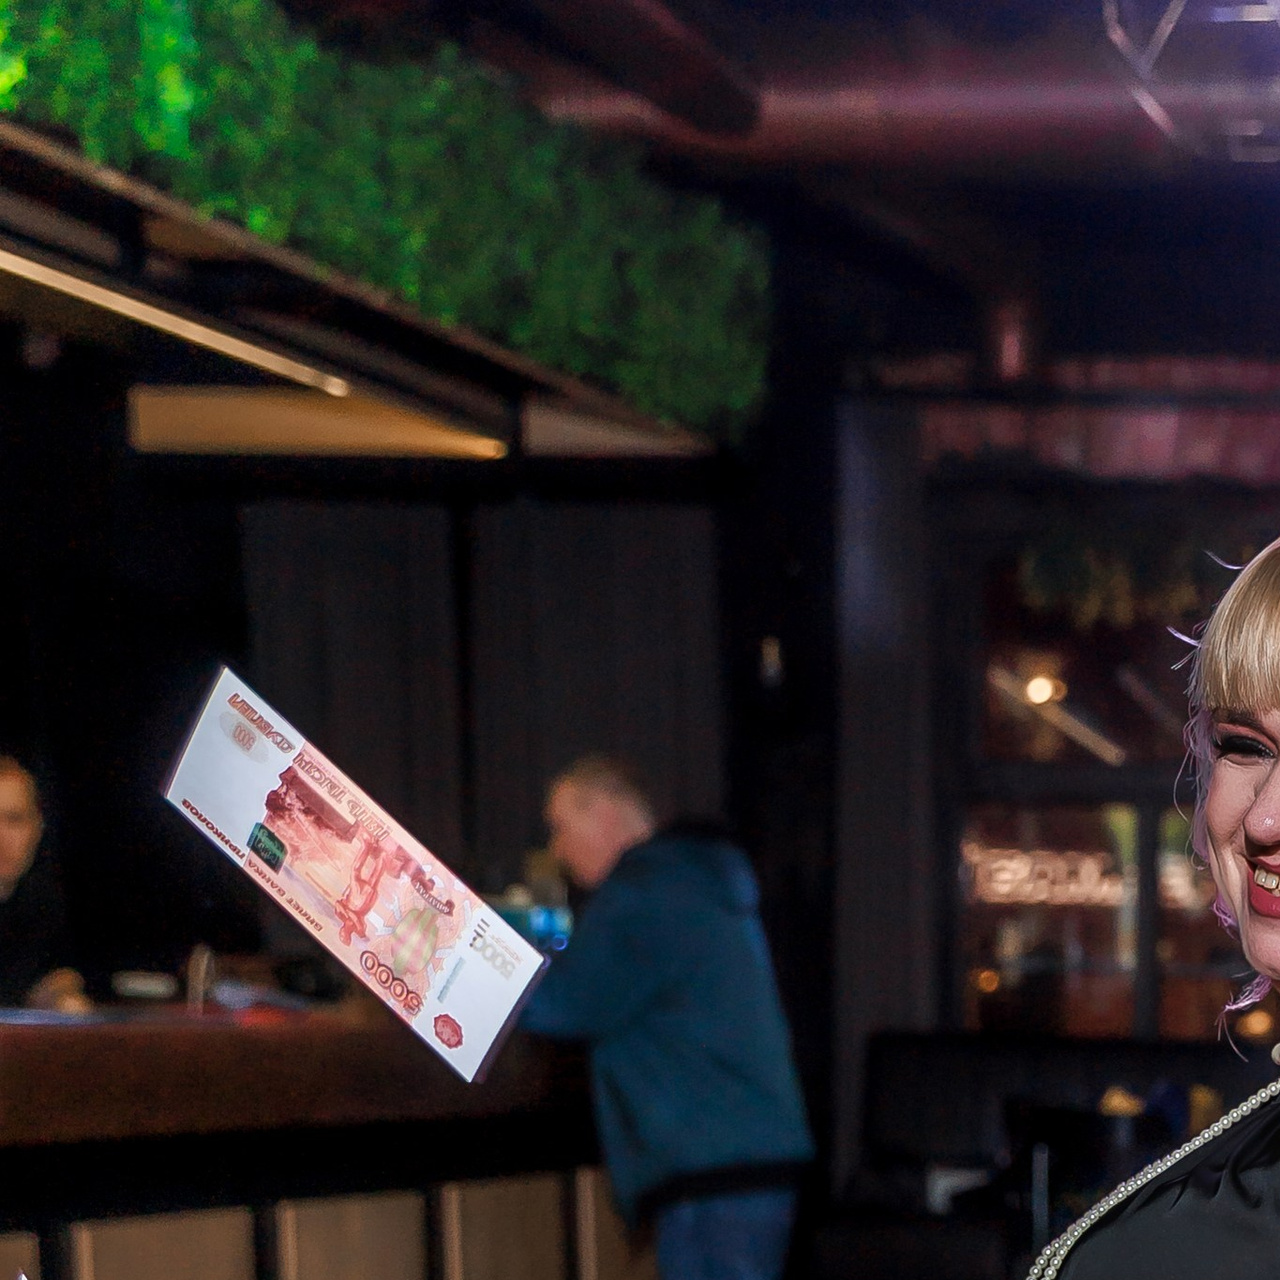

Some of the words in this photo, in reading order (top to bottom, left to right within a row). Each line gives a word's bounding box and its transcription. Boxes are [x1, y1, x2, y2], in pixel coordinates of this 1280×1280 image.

[229, 691, 293, 756] ДУБЛЕЙ
[295, 752, 344, 802] ТЫСЯЧ
[182, 798, 244, 859] ПРИКОЛОВ
[248, 860, 284, 896] БАНКА
[287, 896, 321, 931] БИЛЕТ
[358, 948, 423, 1016] 5000
